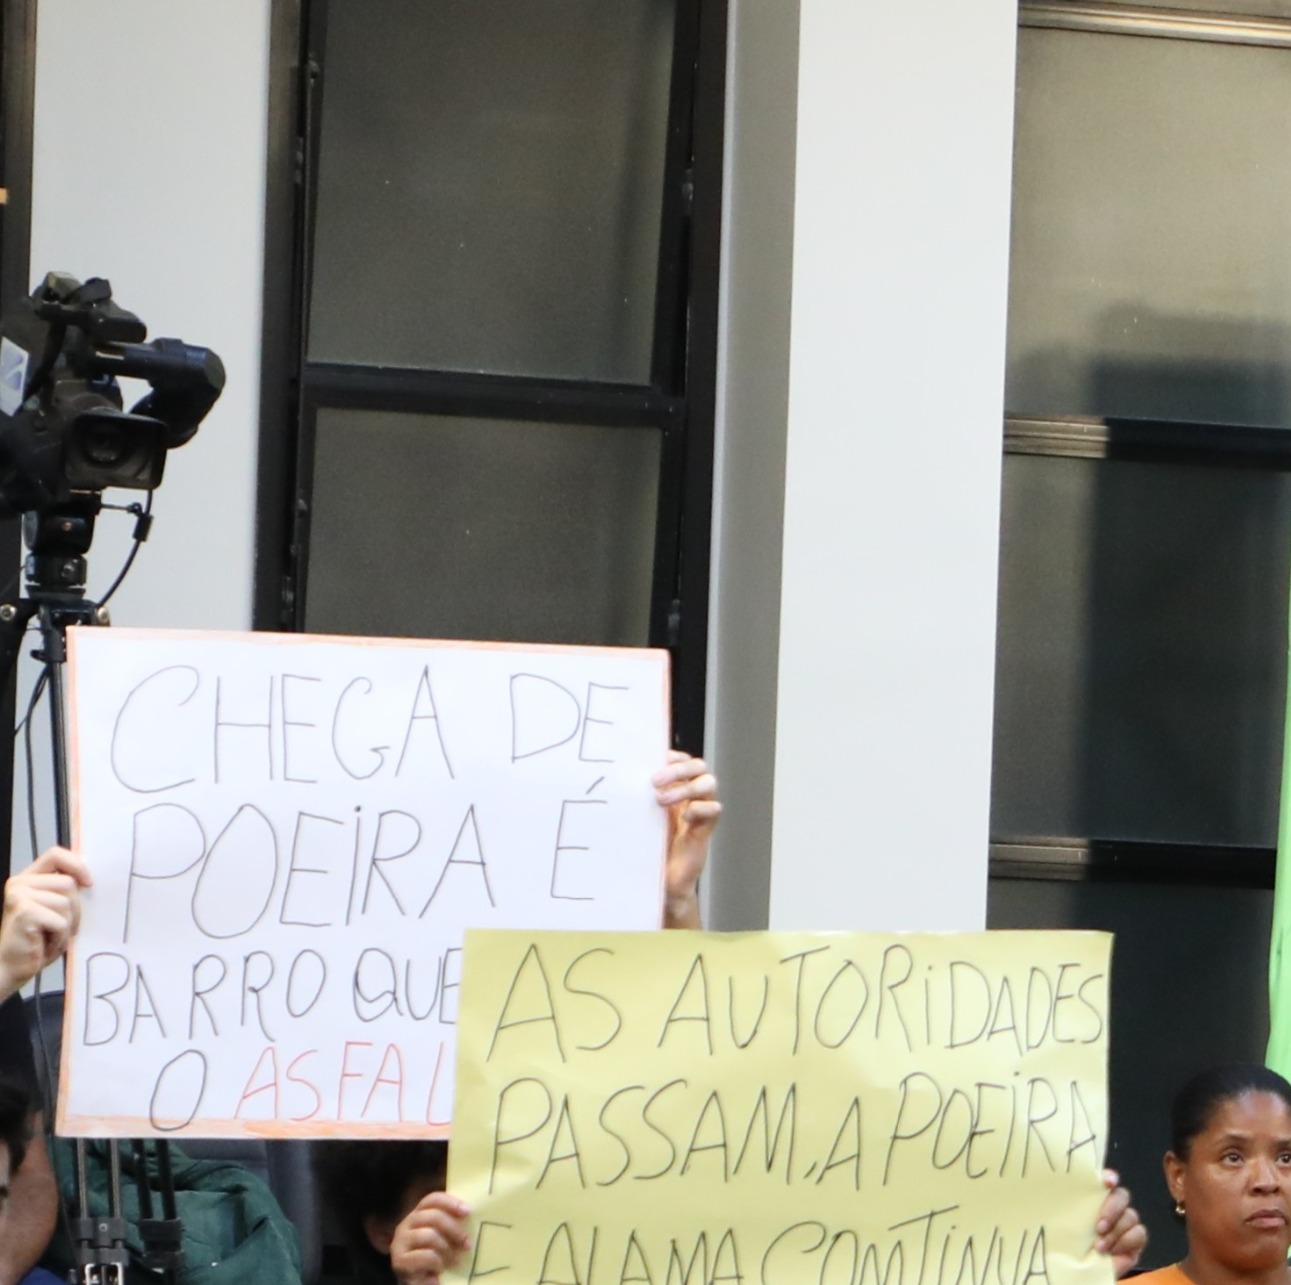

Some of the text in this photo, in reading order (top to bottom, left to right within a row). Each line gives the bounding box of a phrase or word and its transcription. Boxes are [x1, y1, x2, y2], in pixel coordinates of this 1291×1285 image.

[109, 664, 630, 794] CHEGA DE
[550, 775, 609, 901] É
[352, 947, 462, 1026] QUE
[486, 943, 623, 1063] AS
[148, 1048, 208, 1132] O
